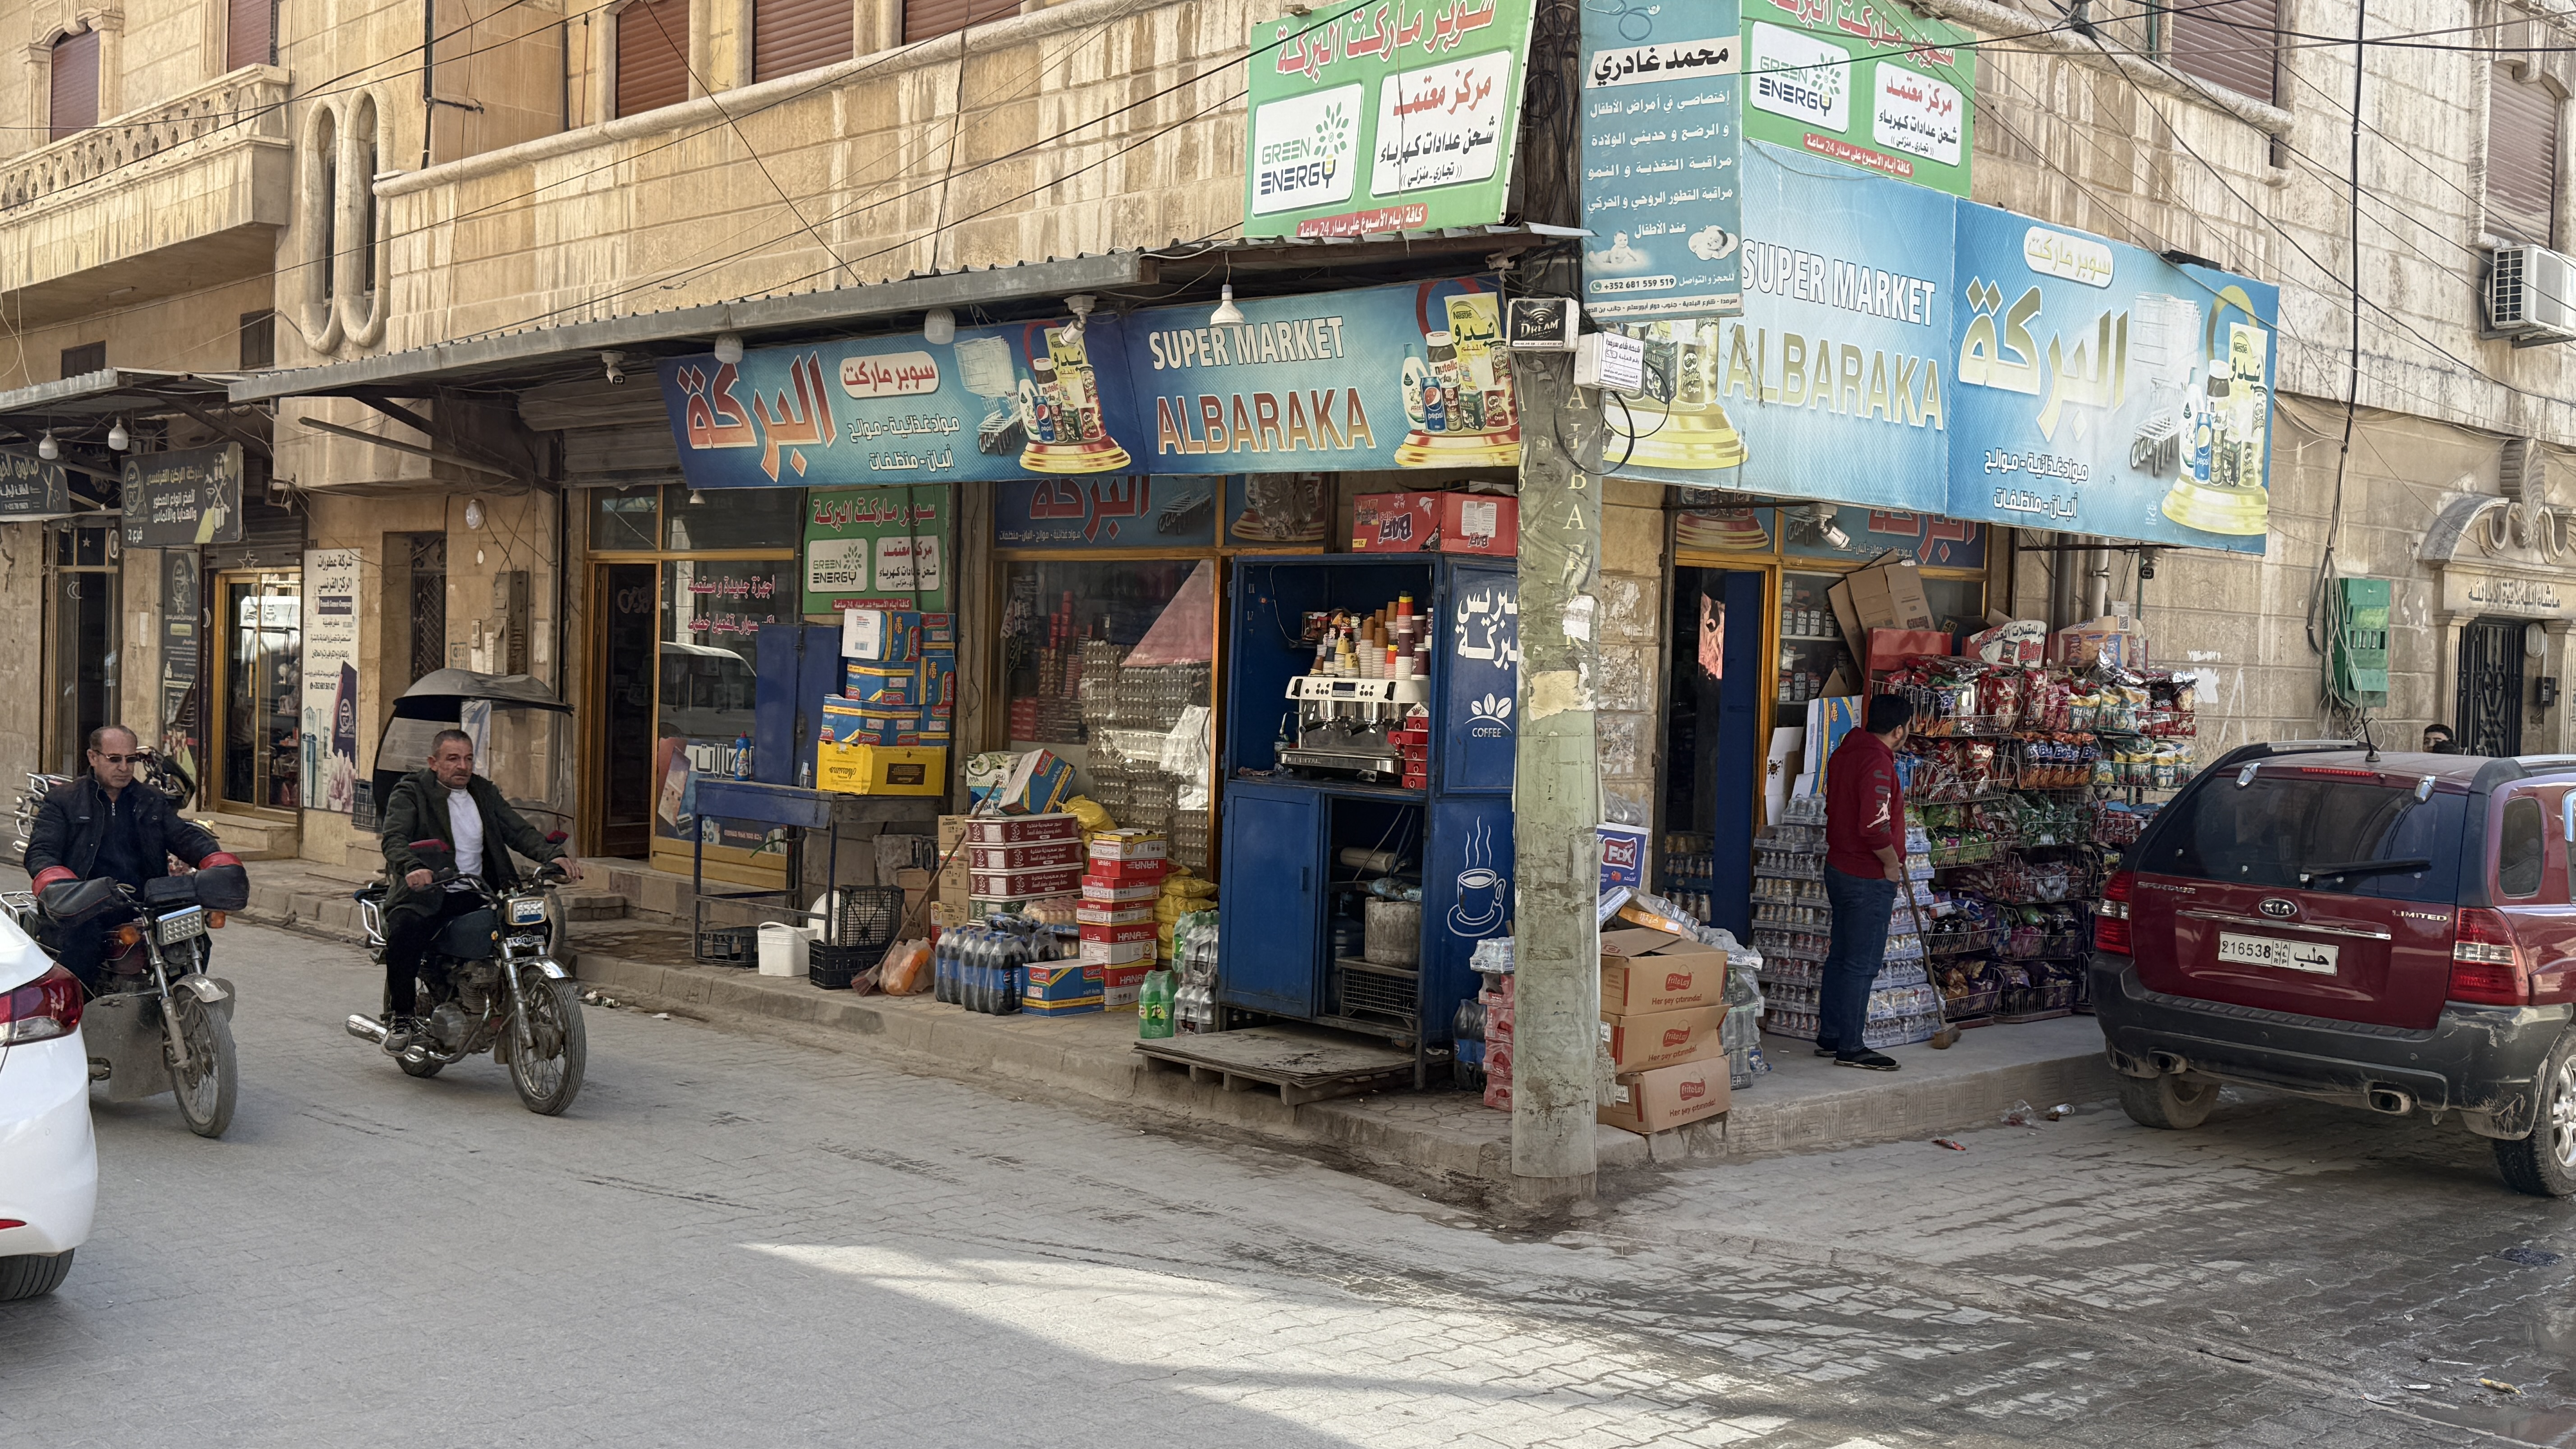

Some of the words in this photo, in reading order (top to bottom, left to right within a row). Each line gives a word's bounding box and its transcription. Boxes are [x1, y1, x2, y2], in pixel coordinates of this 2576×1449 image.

[1345, 2, 1423, 62] ماركت
[1425, 0, 1496, 53] سوبر
[1837, 0, 1901, 50] ماركت
[1276, 17, 1343, 84] البركة
[1665, 46, 1729, 69] محمد
[1904, 32, 1955, 69] سوبر
[1594, 46, 1661, 87] غادري
[1760, 55, 1808, 84] GREEN
[1393, 75, 1445, 116] معتمد
[1447, 68, 1491, 115] مركز
[1759, 76, 1832, 117] ENERGY
[1886, 75, 1924, 102] معتمد
[1590, 98, 1623, 118] الأطفال
[1626, 93, 1660, 114] أمراض
[1664, 95, 1674, 113] في
[1677, 90, 1730, 112] إختصاصي
[1924, 82, 1952, 117] مركز
[1879, 108, 1909, 132] كهرباء
[1910, 115, 1937, 138] عدادات
[1463, 115, 1496, 154] شحن
[1592, 132, 1626, 147] الولادة
[1630, 129, 1666, 148] حديثي
[1670, 129, 1677, 142] و
[1681, 123, 1719, 141] الرضع
[1723, 124, 1730, 137] و
[1937, 125, 1958, 145] شحن
[1262, 137, 1311, 165] GREEN
[1380, 137, 1422, 166] كهرباء
[1422, 130, 1461, 157] عدادات
[1825, 140, 1835, 153] 24
[1624, 165, 1631, 178] و
[1636, 158, 1684, 176] التغذية
[1689, 154, 1733, 170] مراقبة
[1260, 156, 1336, 195] ENERGY
[1587, 164, 1619, 180] النمو
[1622, 197, 1628, 209] و
[1631, 191, 1666, 211] الروحي
[1668, 188, 1699, 205] التطور
[1702, 186, 1733, 202] مراقبة
[1587, 195, 1620, 214] الحركي
[1406, 206, 1424, 223] كافة
[1300, 221, 1319, 237] ساعة
[1320, 221, 1329, 236] 24
[1634, 220, 1666, 239] الأطفال
[1669, 222, 1687, 234] عند
[2027, 235, 2075, 272] ماركت
[2078, 246, 2111, 277] سوبر
[1604, 282, 1624, 290] +352
[1625, 281, 1640, 289] 681
[1643, 279, 1657, 288] 559
[1660, 278, 1674, 286] 519
[1679, 275, 1707, 287] التواصل
[1712, 273, 1735, 284] للحجز
[1742, 239, 1826, 305] SUPER
[1832, 259, 1936, 327] MARKET
[1521, 318, 1561, 338] DREAM
[1149, 327, 1233, 371] SUPER
[1233, 316, 1344, 365] MARKET
[1435, 359, 1458, 375] nutella
[1958, 276, 2129, 442] البركة
[843, 360, 892, 393] ماركت
[893, 361, 936, 391] سوبر
[1681, 370, 1700, 390] Pringles
[1723, 322, 1944, 431] ALBARAKA
[1042, 383, 1059, 395] nutella
[677, 350, 837, 483] البركة
[1157, 386, 1376, 455] ALBARAKA
[1428, 412, 1444, 421] pepsi
[847, 418, 883, 443] موالح
[869, 451, 919, 471] منظفات
[926, 443, 955, 473] ألبان
[1984, 447, 2019, 475] موالح
[2197, 456, 2210, 466] pepsi
[1993, 487, 2042, 513] منظفات
[2050, 492, 2078, 521] ألبان
[813, 498, 853, 533] البركة
[855, 497, 898, 528] ماركت
[128, 529, 132, 541] 2
[133, 526, 143, 543] فرع
[883, 541, 910, 557] معتمد
[317, 555, 337, 571] عطورات
[338, 554, 353, 570] شركة
[813, 559, 842, 570] GREEN
[922, 563, 937, 579] شحن
[813, 571, 857, 585] ENERGY
[879, 566, 900, 580] كهرباء
[318, 577, 338, 595] الفرنسي
[338, 576, 352, 593] الركن
[716, 581, 722, 598] و
[723, 575, 750, 599] جديدة
[1472, 727, 1502, 738] COFFEE
[1608, 845, 1634, 864] FOX
[1134, 860, 1159, 869] HANA
[2264, 903, 2291, 915] KIA
[2392, 909, 2448, 922] LIMITED
[1117, 931, 1141, 941] HANA
[2221, 940, 2272, 959] 216538
[2294, 946, 2330, 967] حلب
[1119, 974, 1144, 984] HANA
[1651, 997, 1663, 1005] Her
[1648, 1053, 1660, 1062] Her
[1669, 1109, 1680, 1117] Her
